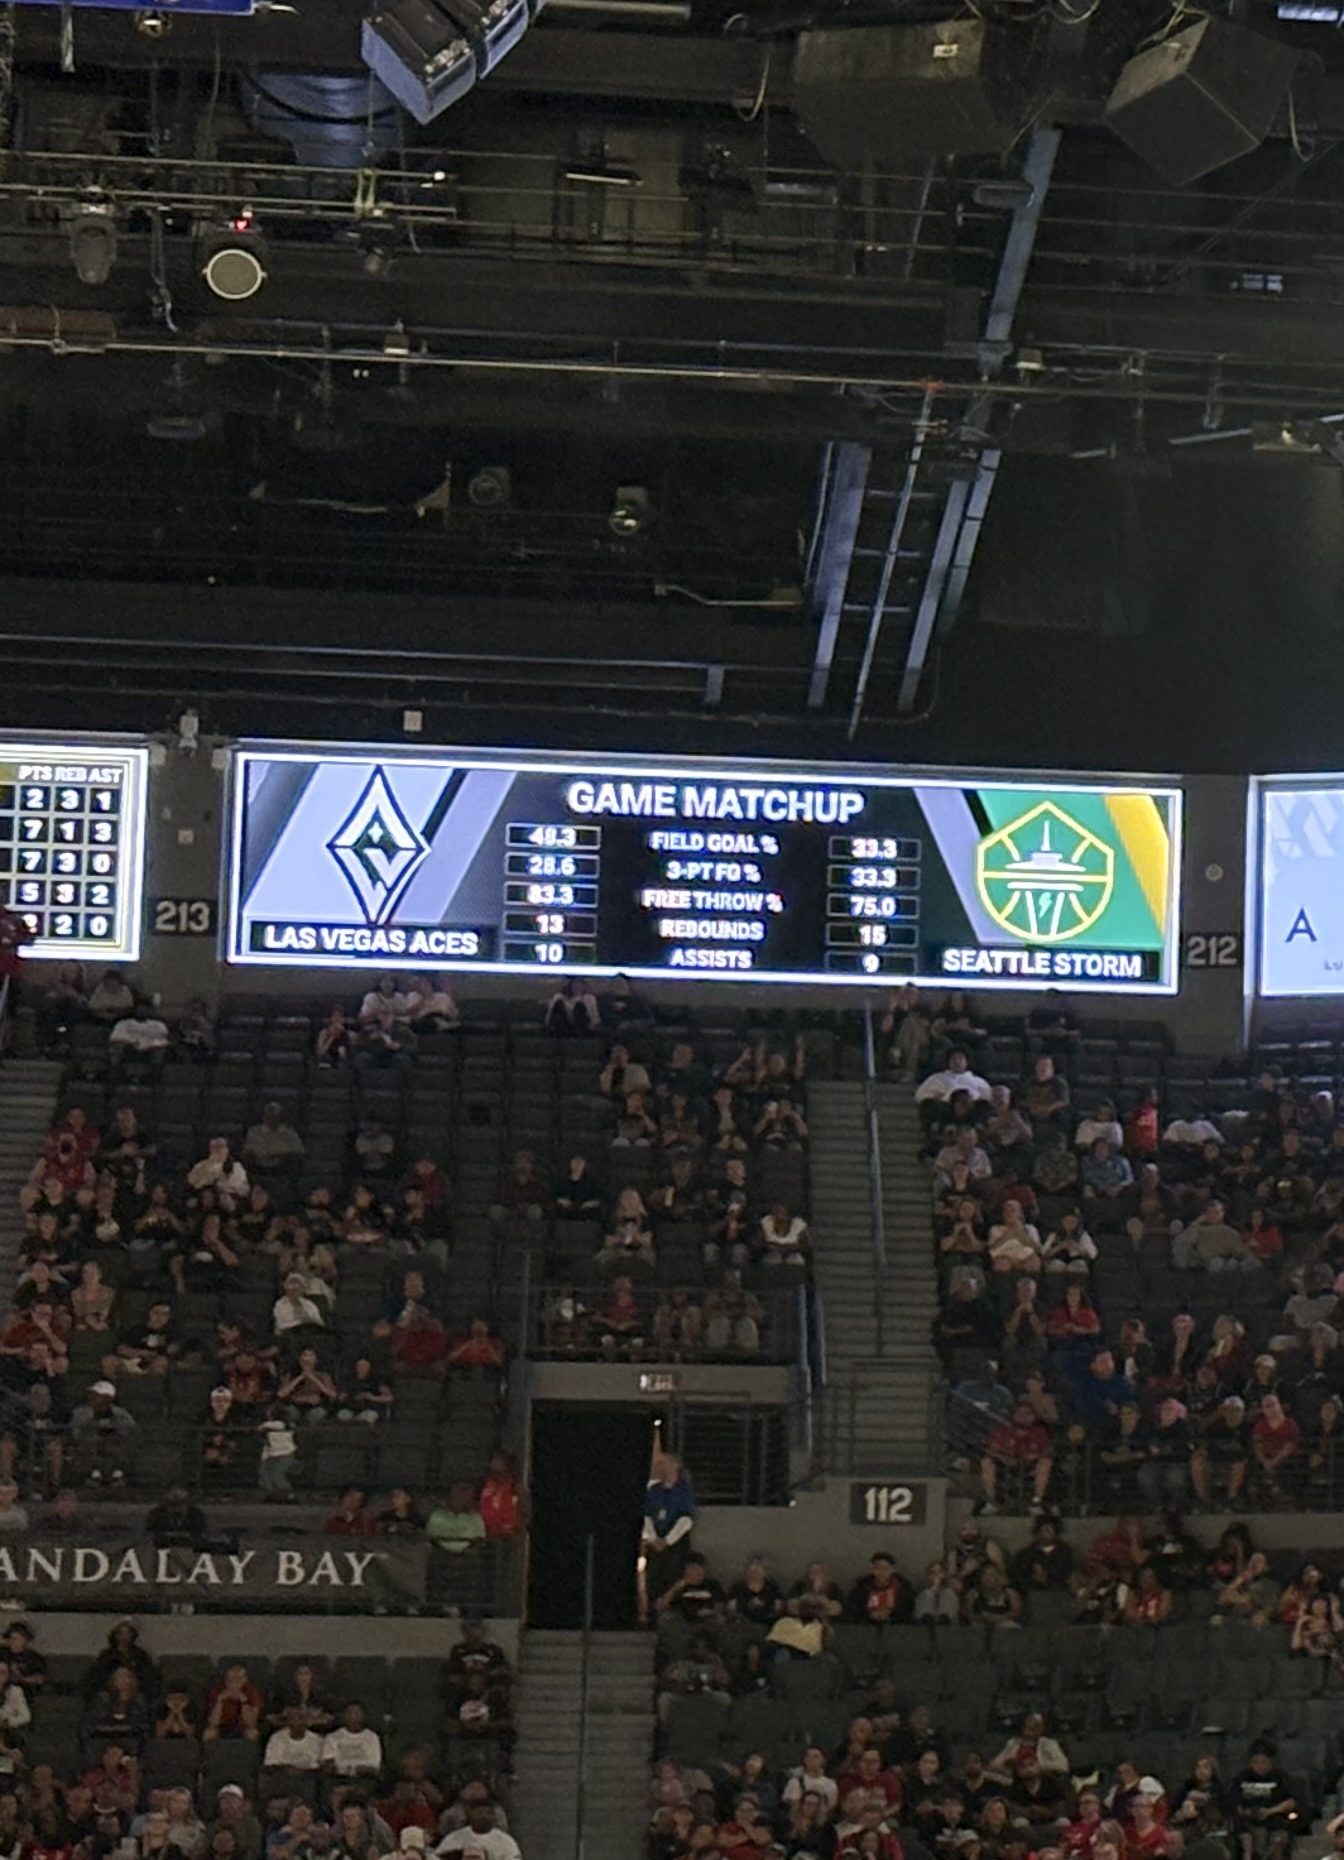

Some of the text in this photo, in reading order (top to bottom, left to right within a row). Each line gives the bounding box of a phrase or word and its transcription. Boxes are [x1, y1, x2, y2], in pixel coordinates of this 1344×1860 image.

[19, 765, 123, 783] PTS REB AST
[26, 788, 111, 810] 2 3 1
[568, 781, 865, 823] GAME MATCHUP
[24, 819, 112, 842] 7 1 3
[651, 831, 779, 855] FIELD GOAL %
[23, 851, 110, 873] 7 3 0
[528, 855, 576, 876] 28.6
[666, 861, 714, 880] 3-PT
[743, 864, 761, 883] %
[22, 882, 109, 904] 5 3 2
[641, 889, 783, 913] FREE THROW %
[155, 901, 210, 932] 213
[850, 897, 896, 916] 75.0
[56, 915, 73, 935] 2
[90, 916, 107, 936] 0
[535, 914, 564, 934] 13
[659, 920, 764, 941] REBOUNDS
[264, 925, 479, 955] LAS VEGAS ACES
[1187, 936, 1237, 965] 212
[535, 944, 564, 962] 10
[670, 949, 752, 968] ASSISTS
[863, 953, 880, 973] 9
[943, 948, 1142, 978] SEATTLE STORM
[865, 1487, 913, 1522] 112
[276, 1551, 374, 1586] BAY
